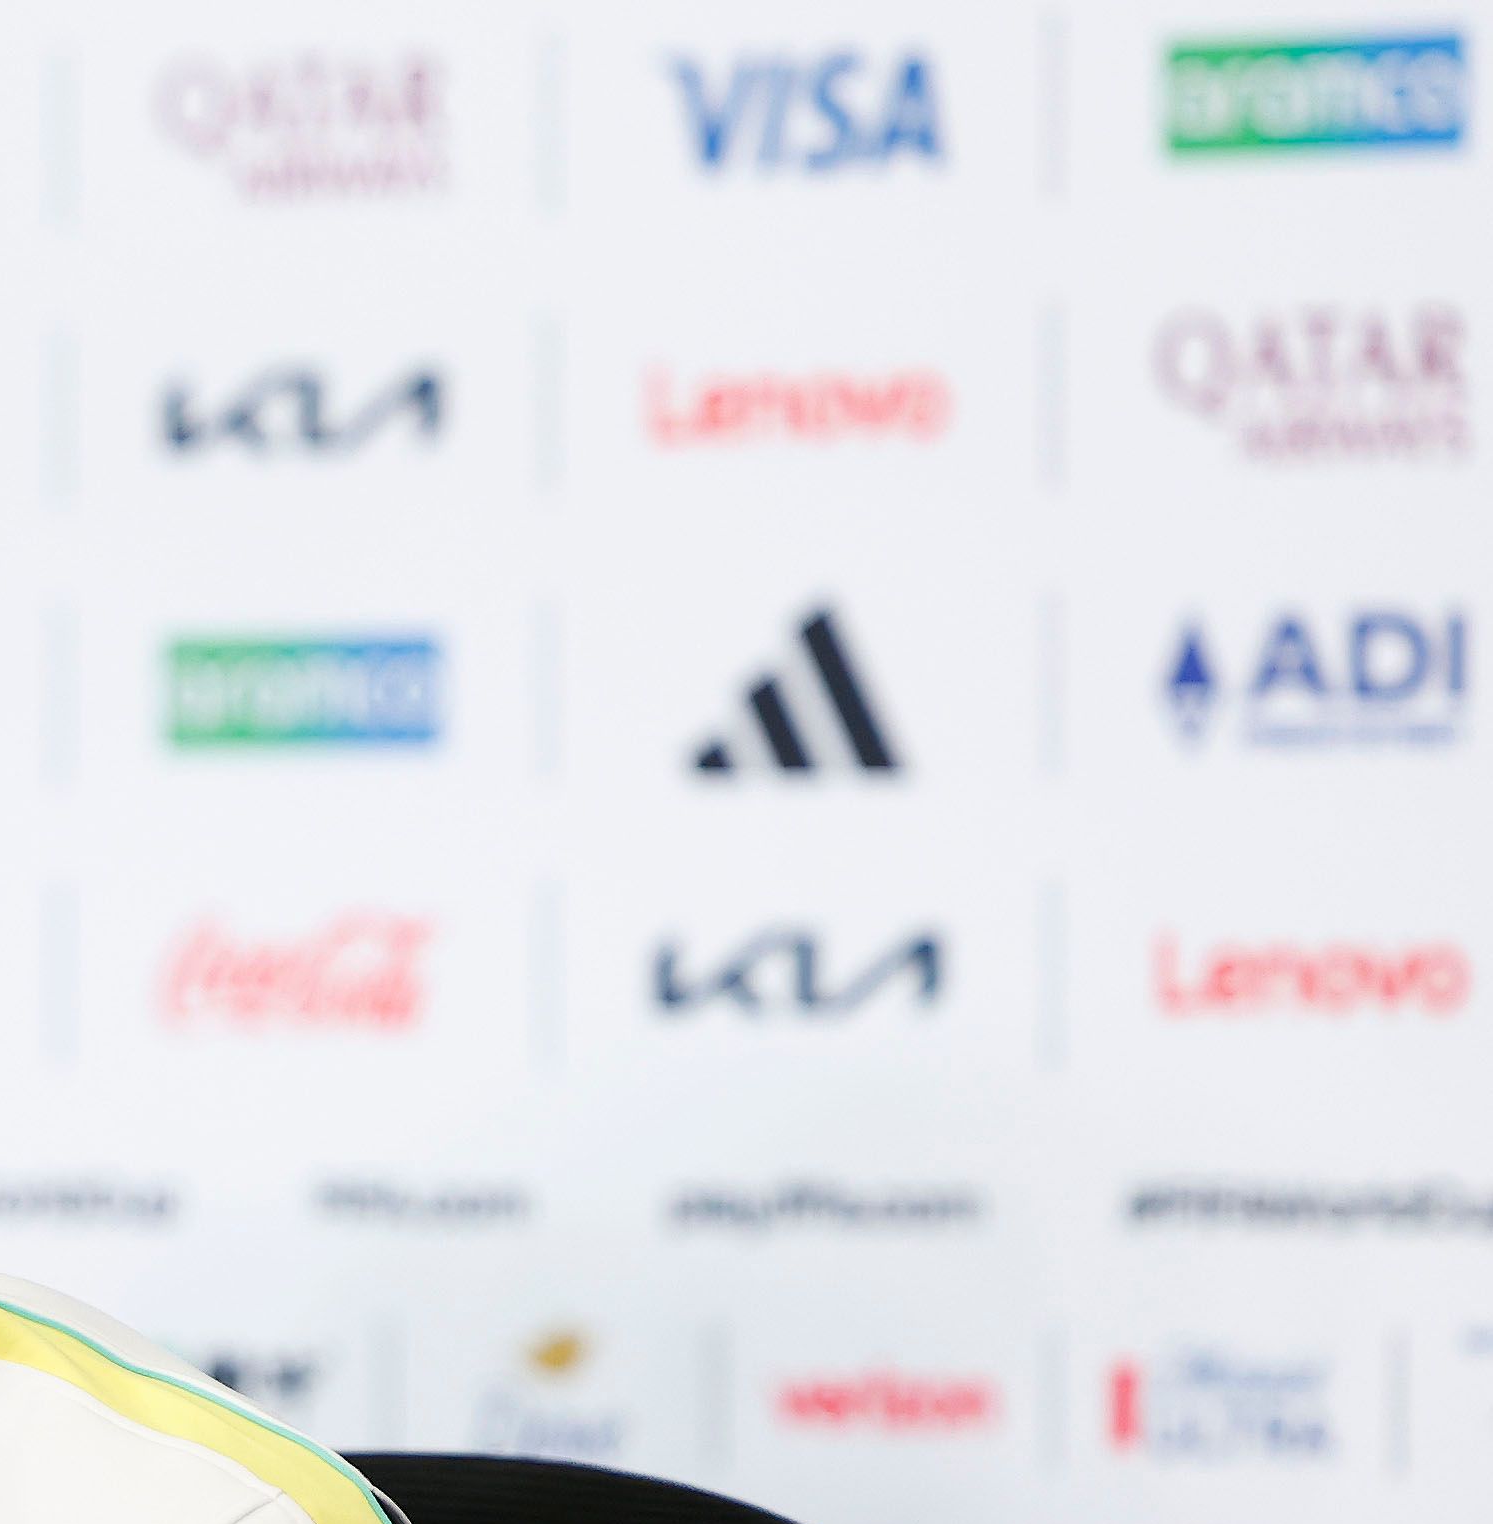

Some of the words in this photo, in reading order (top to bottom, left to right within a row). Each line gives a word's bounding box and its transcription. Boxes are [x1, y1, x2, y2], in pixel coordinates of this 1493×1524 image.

[677, 55, 942, 170] VISA
[1155, 305, 1469, 412] QATAR
[161, 369, 444, 454] KIA
[650, 375, 947, 443] Lenovo
[1251, 612, 1467, 702] ADI
[654, 934, 943, 1013] KIA
[1159, 947, 1468, 1013] Lenovo
